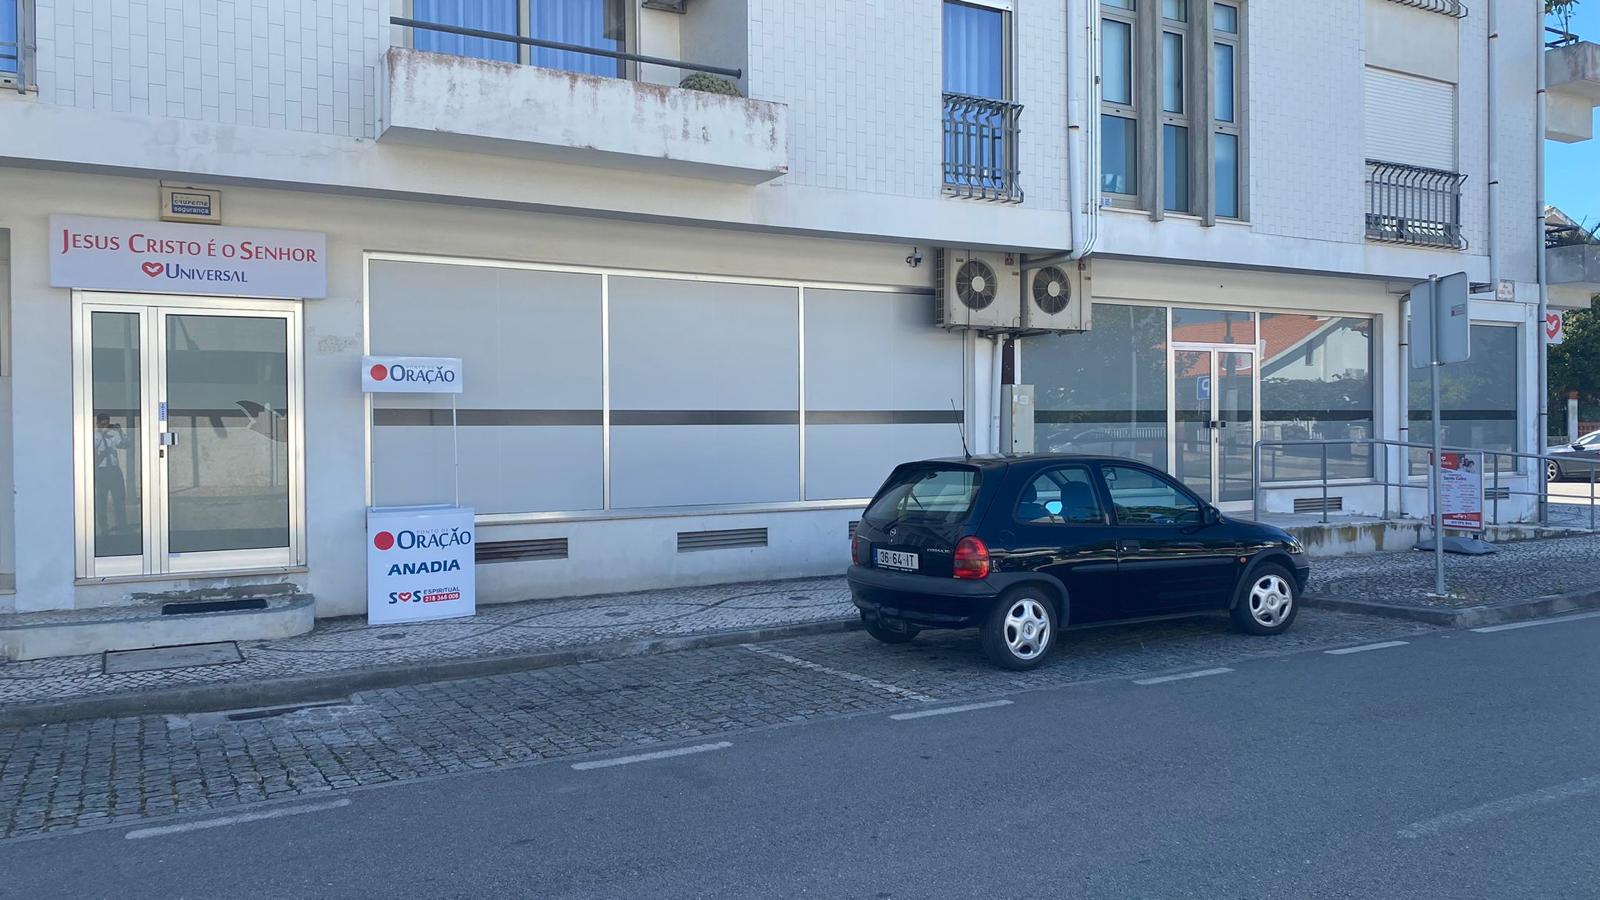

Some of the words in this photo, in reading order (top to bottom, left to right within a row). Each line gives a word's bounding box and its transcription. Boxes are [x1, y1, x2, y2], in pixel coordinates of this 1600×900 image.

[61, 229, 120, 254] JESUS
[128, 233, 201, 256] CRISTO
[207, 239, 216, 257] É
[222, 244, 235, 258] O
[240, 241, 318, 263] SENHOR
[165, 263, 248, 283] UNIVERSAL
[880, 551, 913, 566] 36-64-IT
[388, 560, 460, 575] ANADIA
